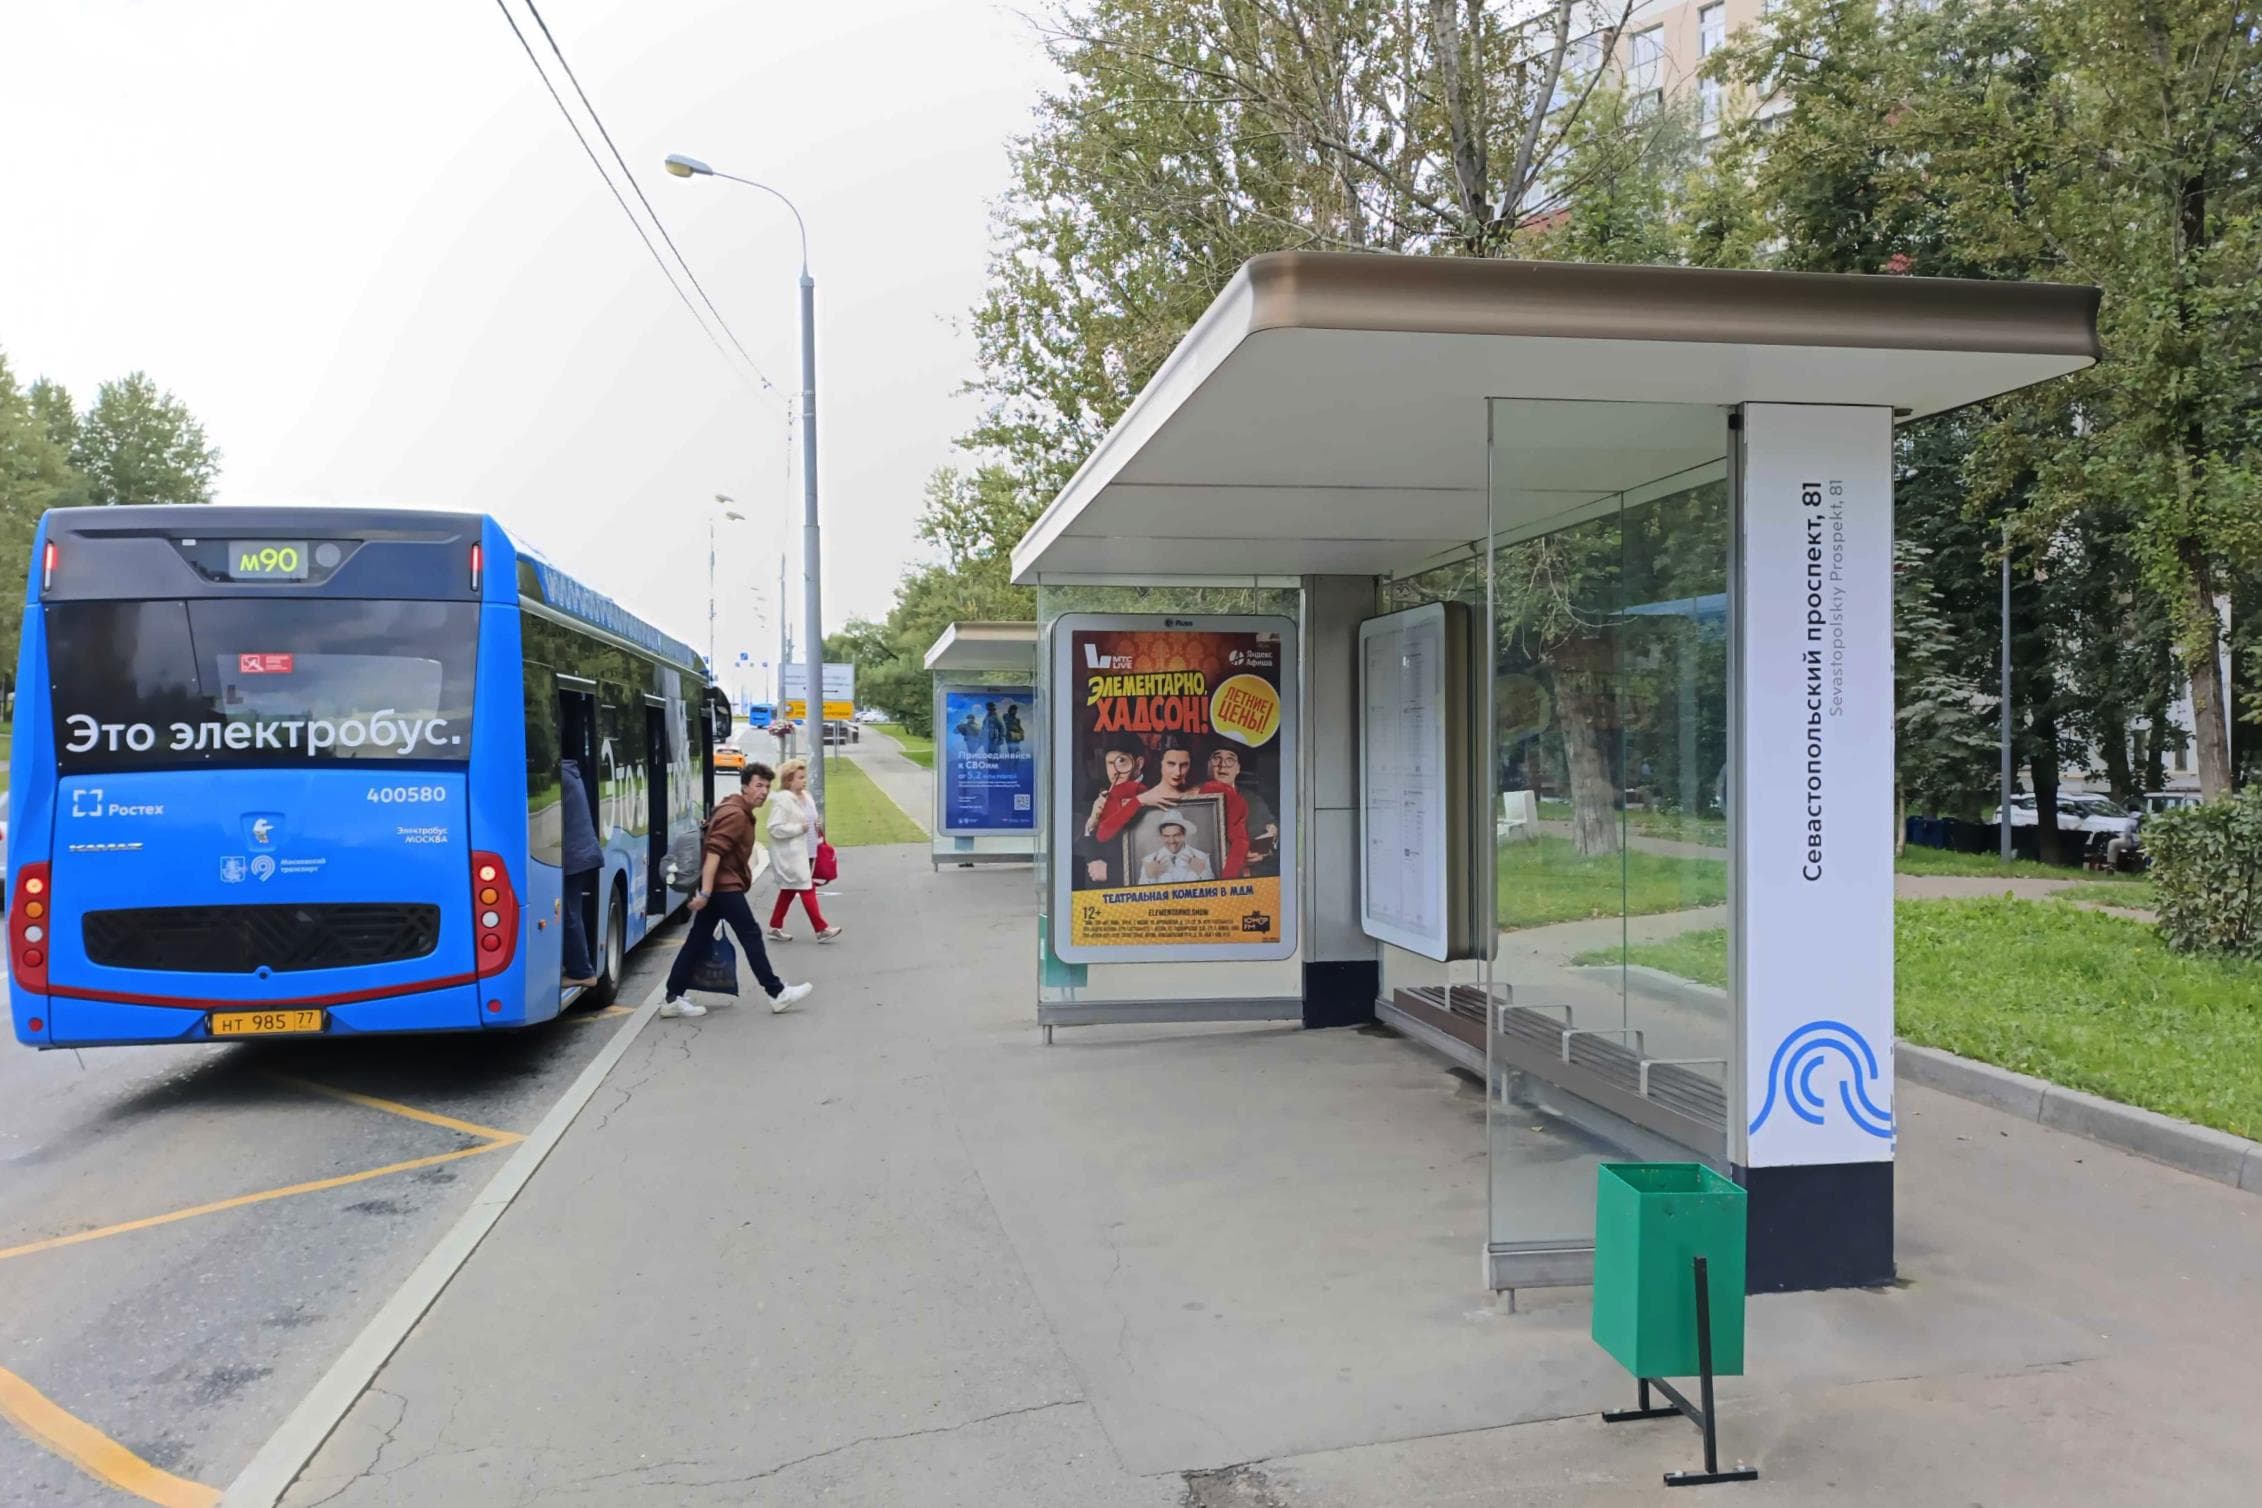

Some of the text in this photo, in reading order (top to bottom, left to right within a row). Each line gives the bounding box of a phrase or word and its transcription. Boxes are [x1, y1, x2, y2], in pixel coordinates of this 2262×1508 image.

[239, 547, 298, 572] м90
[1829, 479, 1848, 716] Sevastopolskiy Prospekt, 81
[1112, 662, 1133, 670] LIVE
[1802, 482, 1826, 881] Севастопольский проспект, 81
[1224, 686, 1270, 713] ЛЕТНИЕ
[1094, 696, 1209, 734] ХАДСОН!
[1217, 699, 1274, 734] ЦЕНЫ!
[65, 708, 462, 757] Это электробус.
[966, 760, 999, 769] СВОим
[366, 786, 446, 803] 400580
[108, 803, 164, 816] Ростех
[396, 826, 448, 836] Электробус
[404, 835, 448, 844] МОСКВА
[1102, 890, 1169, 905] ТЕАТРАЛЬНАЯ
[1172, 888, 1217, 900] КОМЕДИЯ
[1229, 885, 1254, 896] МДМ
[1082, 905, 1102, 920] 12+
[252, 1014, 286, 1031] 985
[296, 1012, 314, 1024] 77
